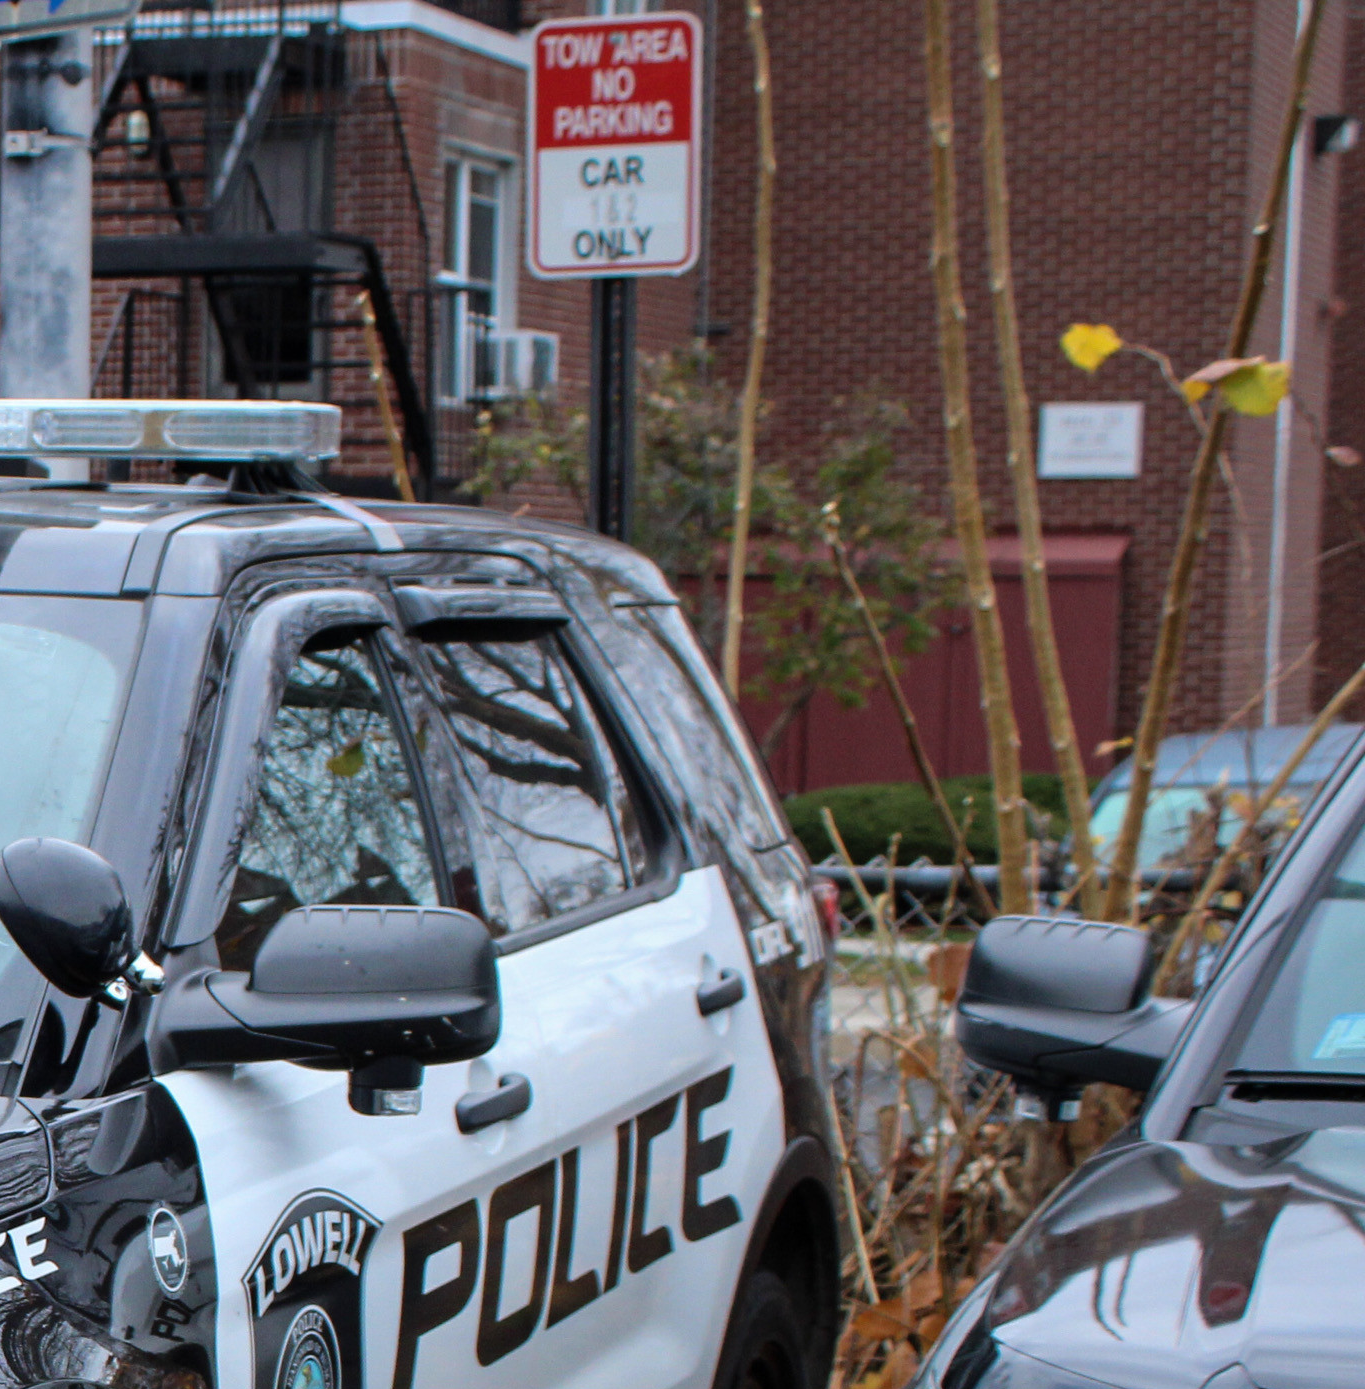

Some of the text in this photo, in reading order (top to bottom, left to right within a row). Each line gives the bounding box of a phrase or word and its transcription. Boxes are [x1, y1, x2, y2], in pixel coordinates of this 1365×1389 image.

[541, 28, 689, 69] TOW AREA
[591, 67, 636, 102] NO
[553, 102, 673, 139] PARKING
[581, 155, 645, 188] CAR
[573, 225, 654, 261] ONLY
[255, 1210, 367, 1318] LOWELL
